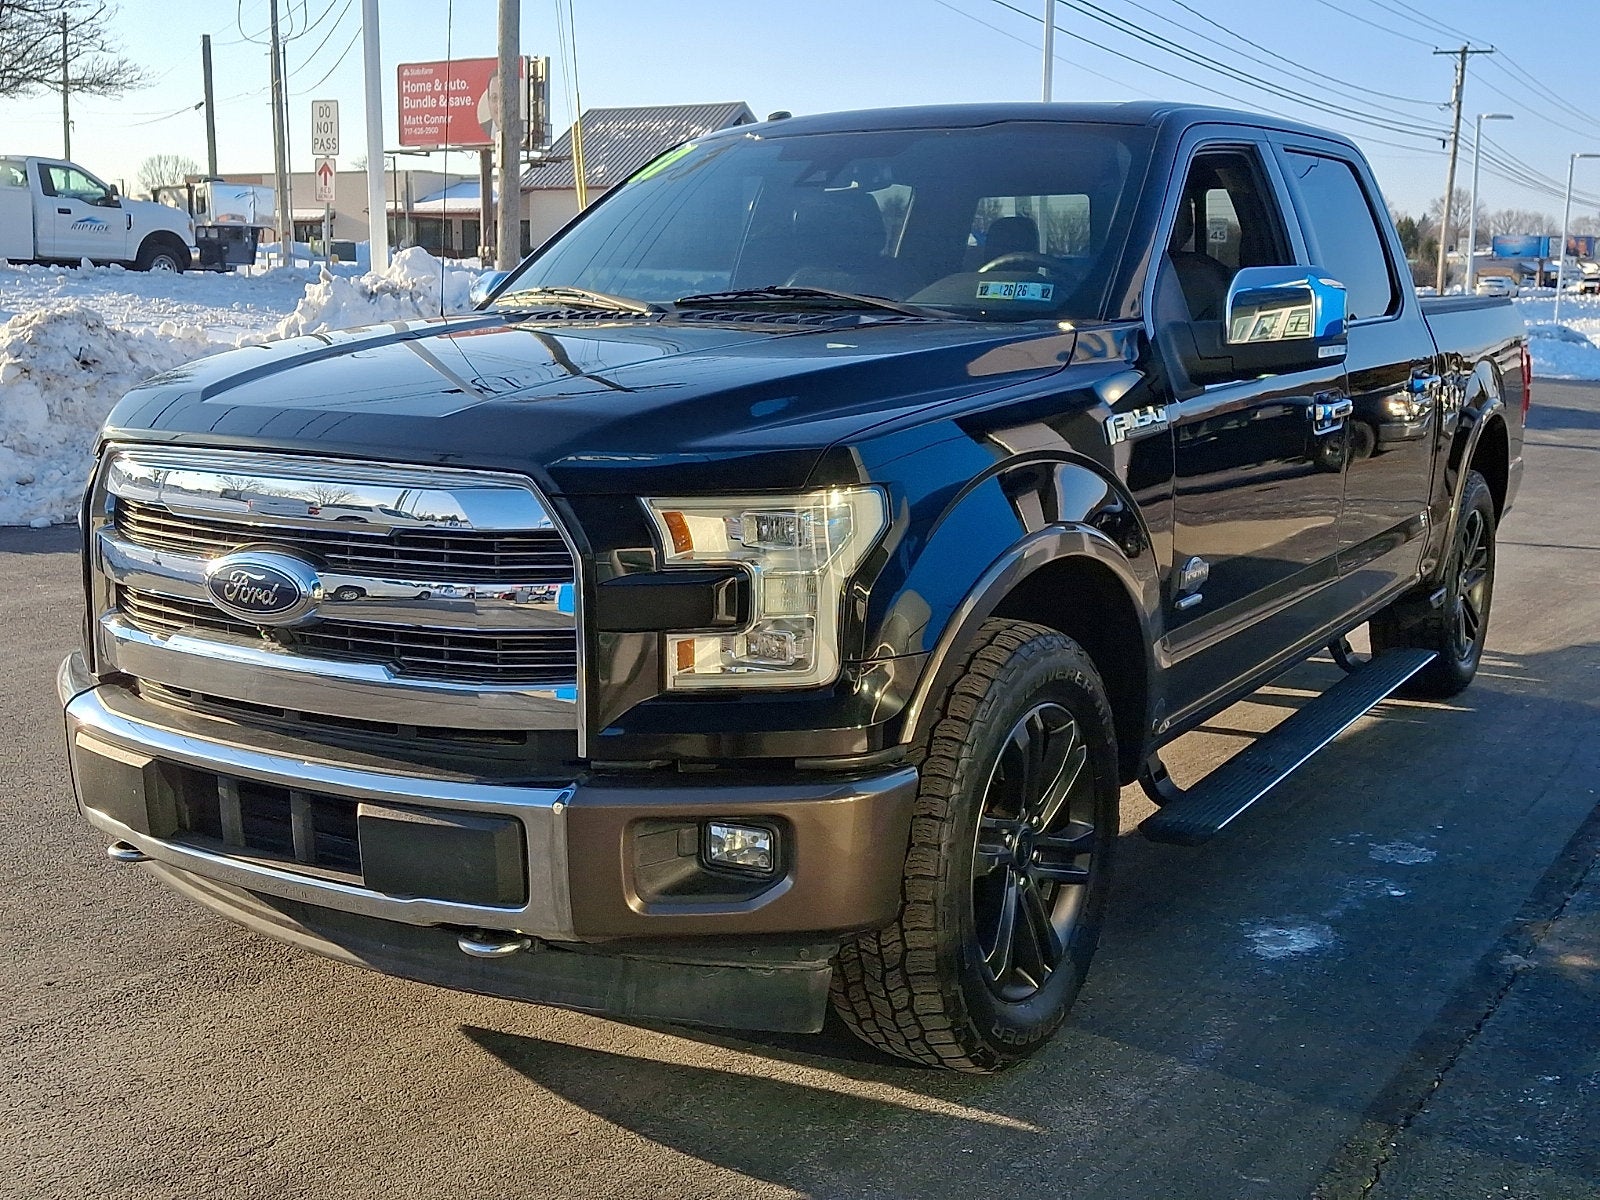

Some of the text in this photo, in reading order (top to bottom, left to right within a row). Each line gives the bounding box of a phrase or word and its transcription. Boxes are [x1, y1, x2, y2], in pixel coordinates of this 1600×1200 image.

[402, 80, 431, 93] Home
[434, 78, 442, 91] &
[403, 94, 475, 109] Bundle & save.
[319, 106, 331, 118] DO
[403, 115, 423, 125] Matt
[316, 121, 334, 134] NOT
[313, 137, 337, 150] PASS
[71, 223, 112, 231] RIPTIDE
[1210, 231, 1226, 240] 45
[979, 284, 1014, 296] 12 26
[1017, 284, 1051, 299] 26 12
[224, 569, 279, 606] Ford
